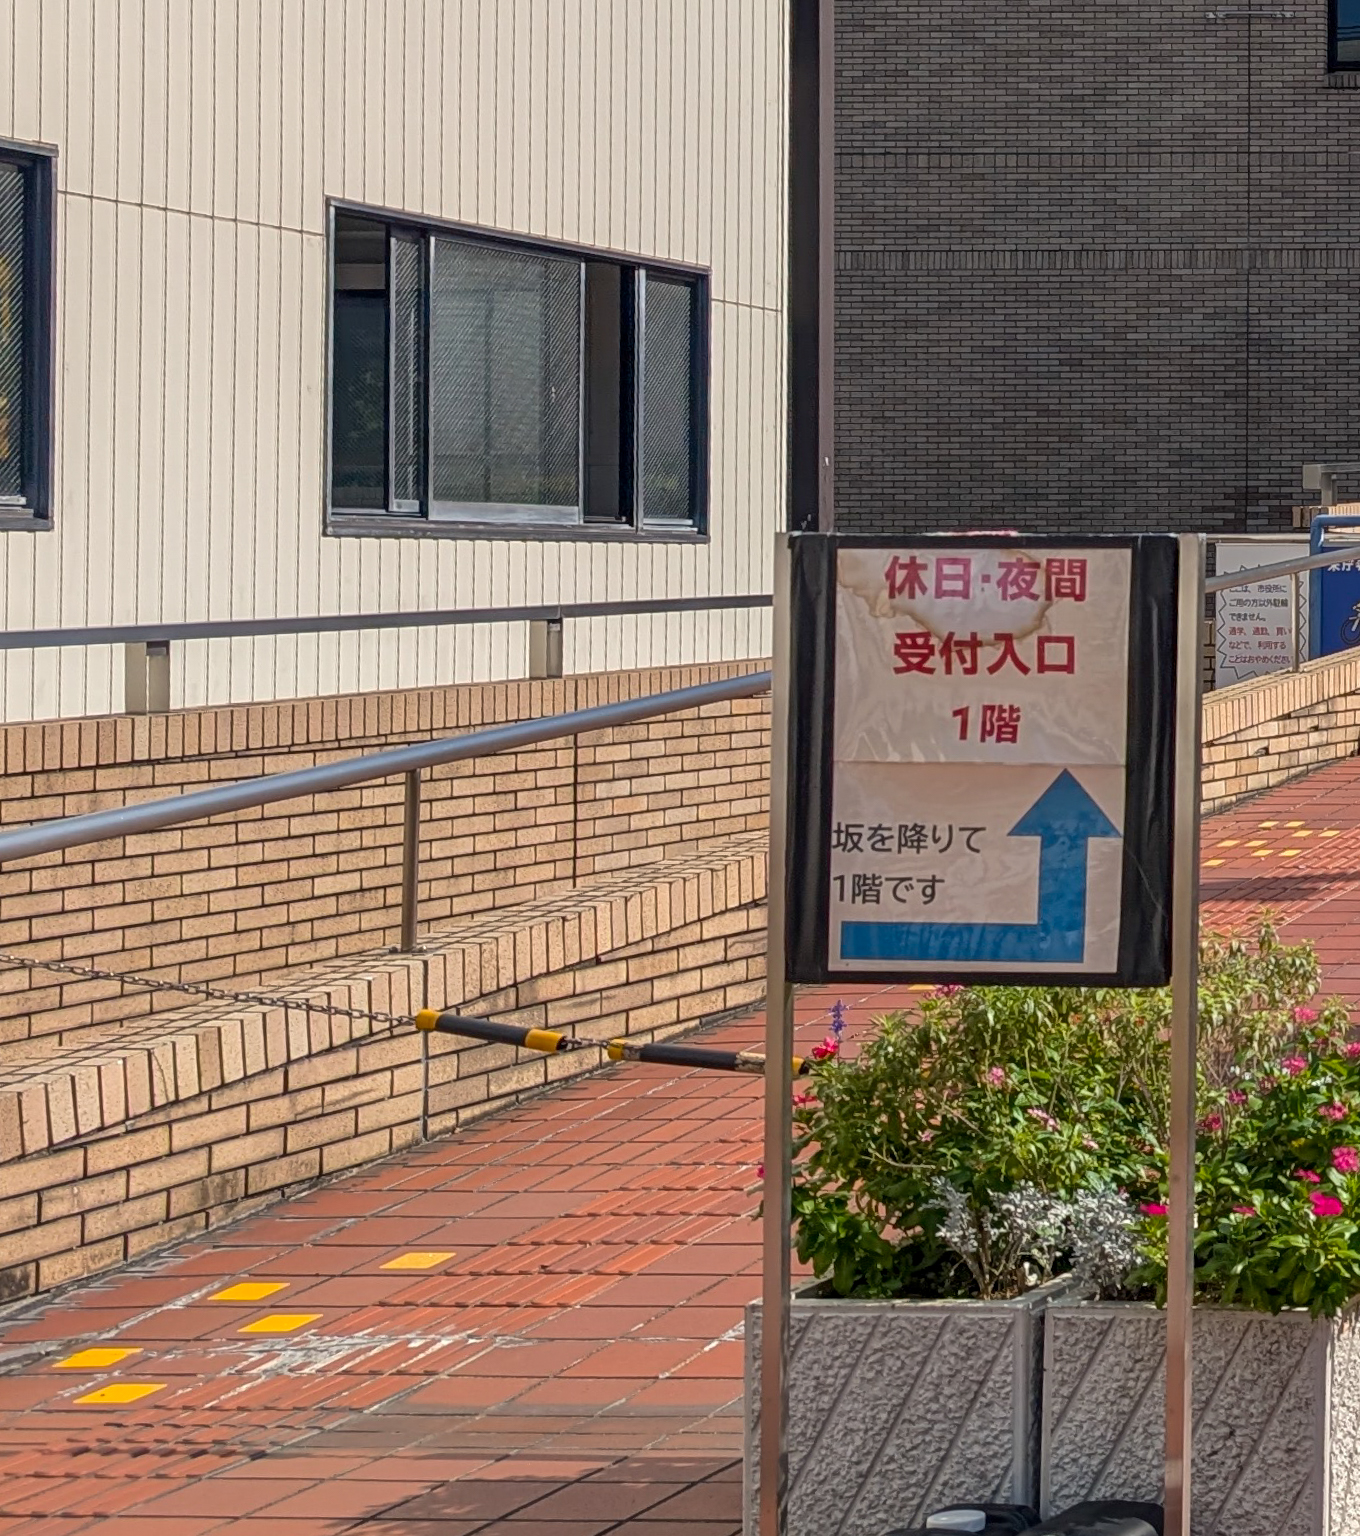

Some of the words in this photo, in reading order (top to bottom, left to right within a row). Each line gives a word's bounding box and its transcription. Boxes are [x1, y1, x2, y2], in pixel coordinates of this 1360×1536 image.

[885, 556, 1088, 602] 休日・夜間
[892, 631, 1077, 676] 受付入口
[951, 704, 1021, 744] 1階
[832, 822, 988, 855] 坂を降りて
[832, 874, 946, 905] 1階です
